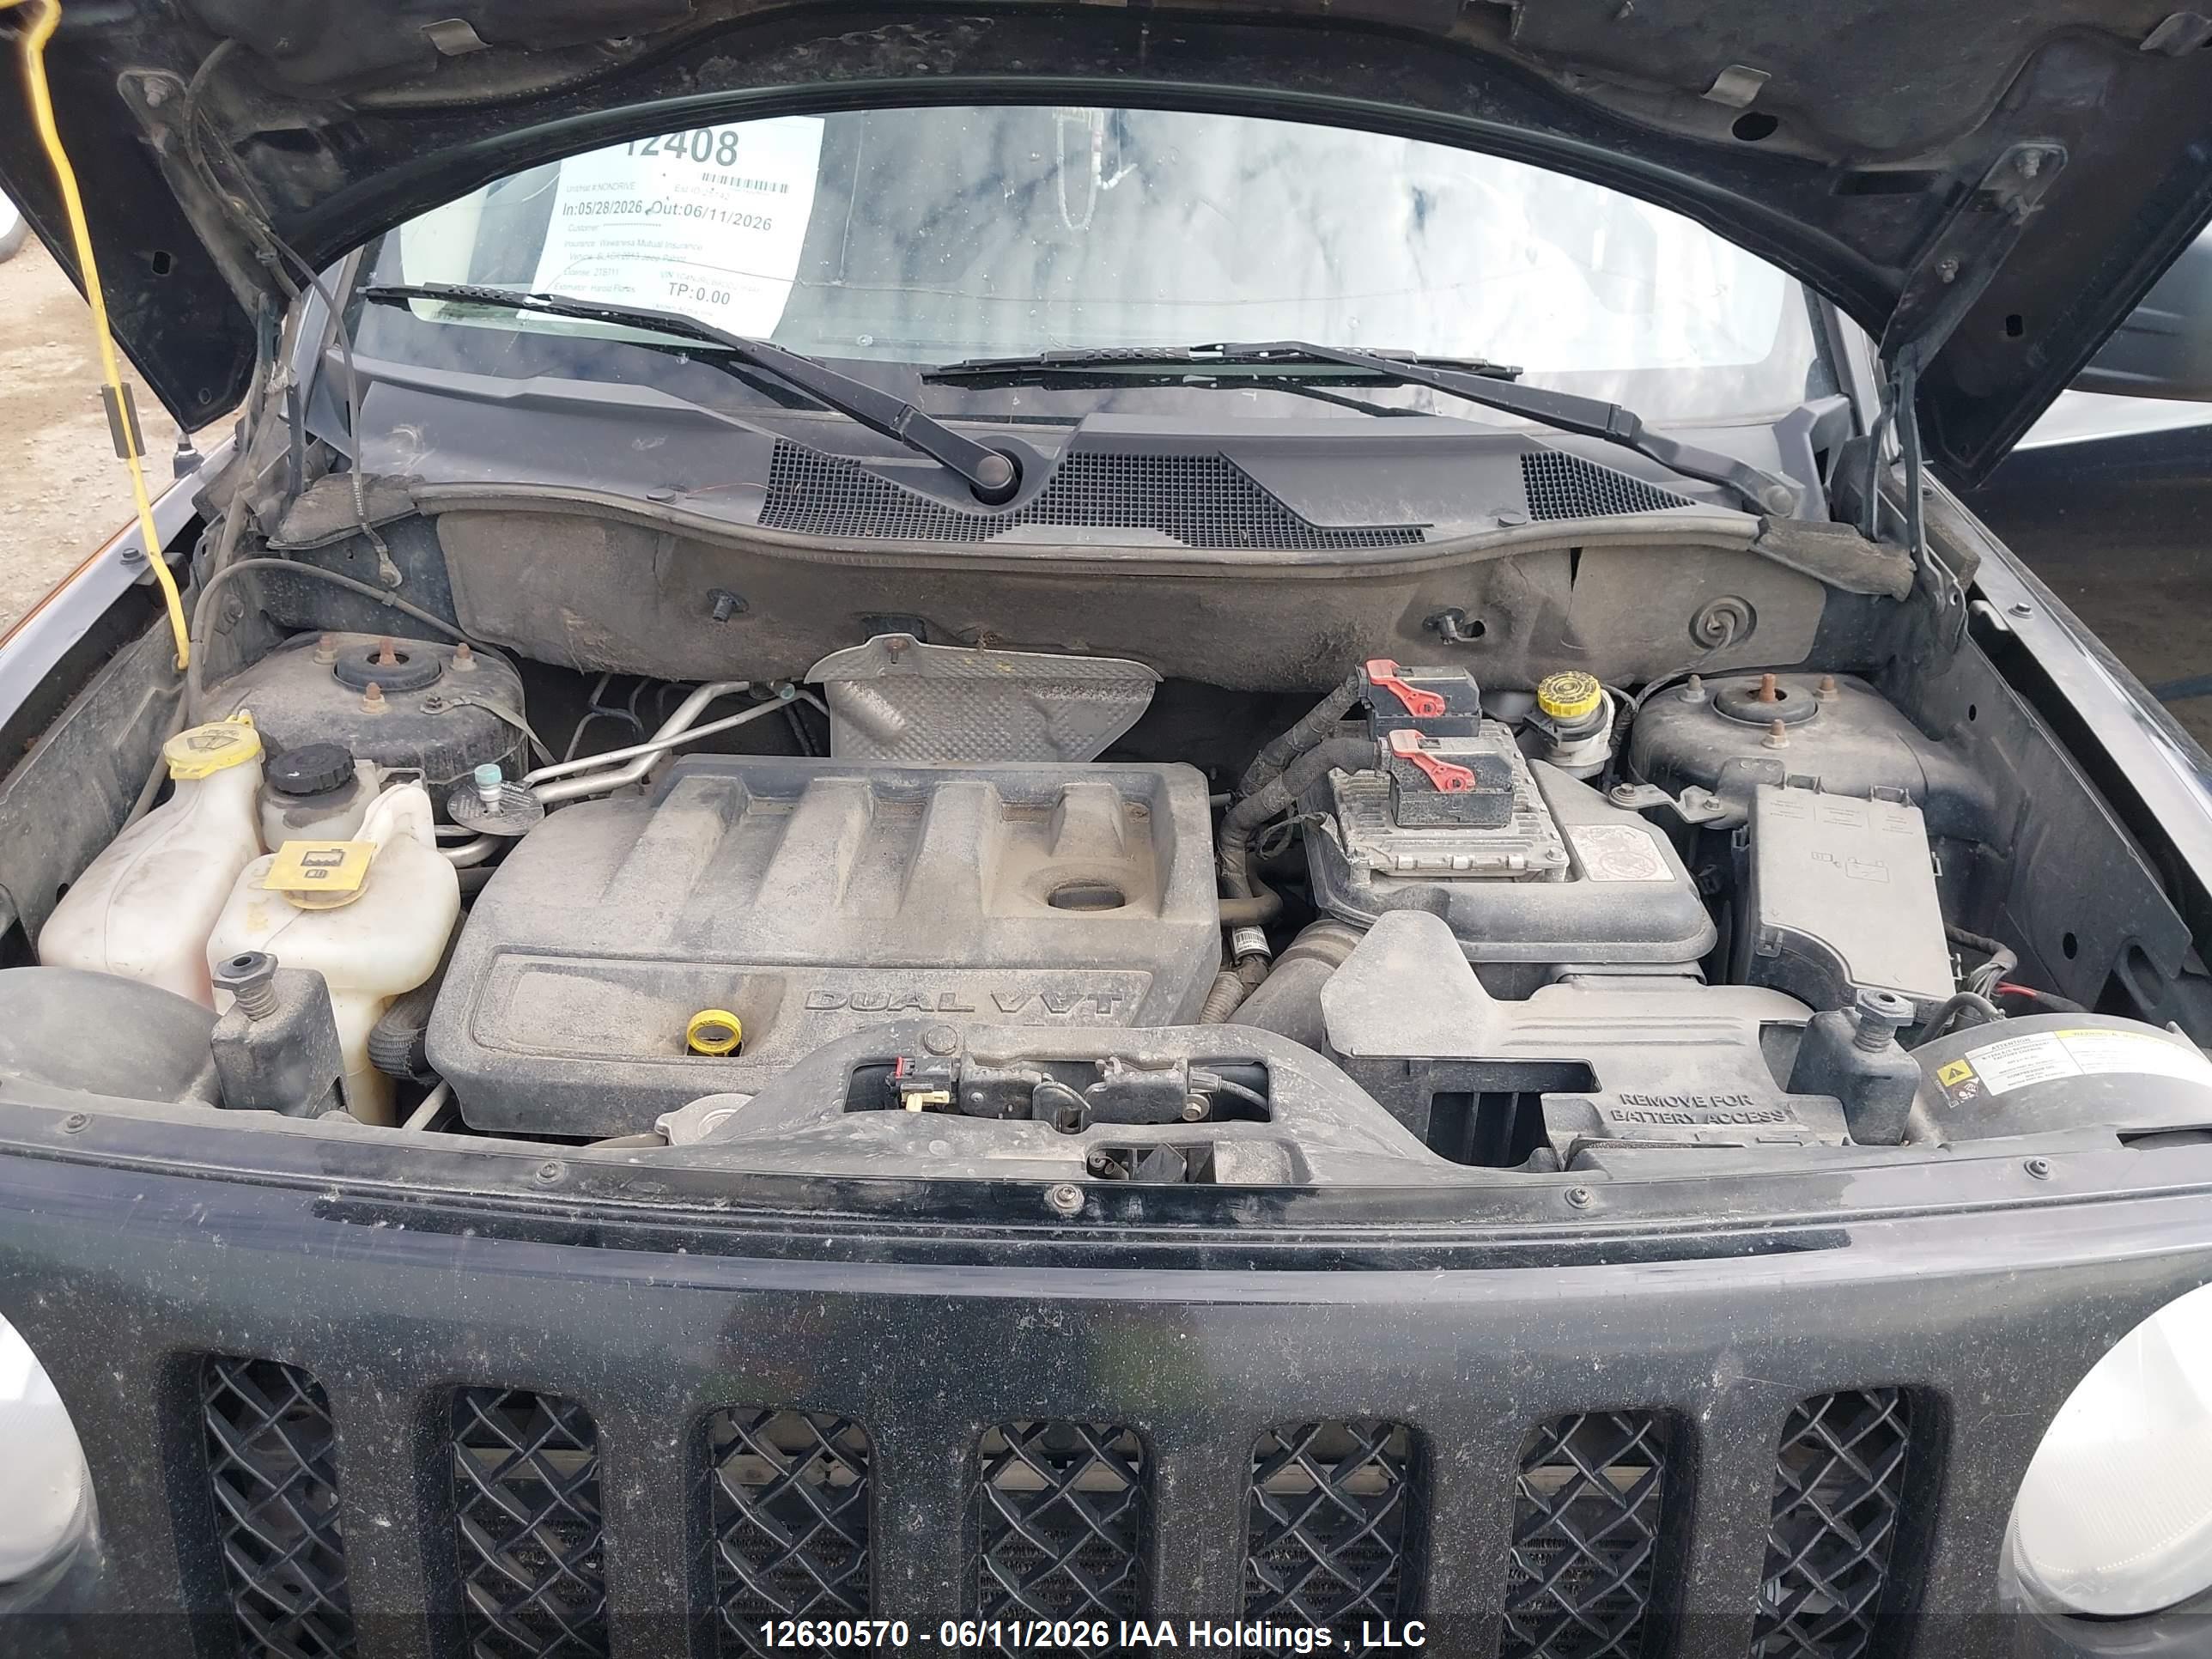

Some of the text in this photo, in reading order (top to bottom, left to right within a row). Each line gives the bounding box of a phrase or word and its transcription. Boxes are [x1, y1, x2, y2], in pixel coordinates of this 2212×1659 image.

[562, 199, 773, 232] In:05/28/2026 Out:06/11/2026
[636, 238, 665, 248] Mutual
[668, 282, 731, 305] TP:0.00
[805, 989, 1125, 1015] DUAL VVT
[1991, 1037, 2031, 1051] ATTENTION
[1620, 1093, 1754, 1109] REMOVE FOR
[1610, 1109, 1786, 1125] BATTERY ACCESS
